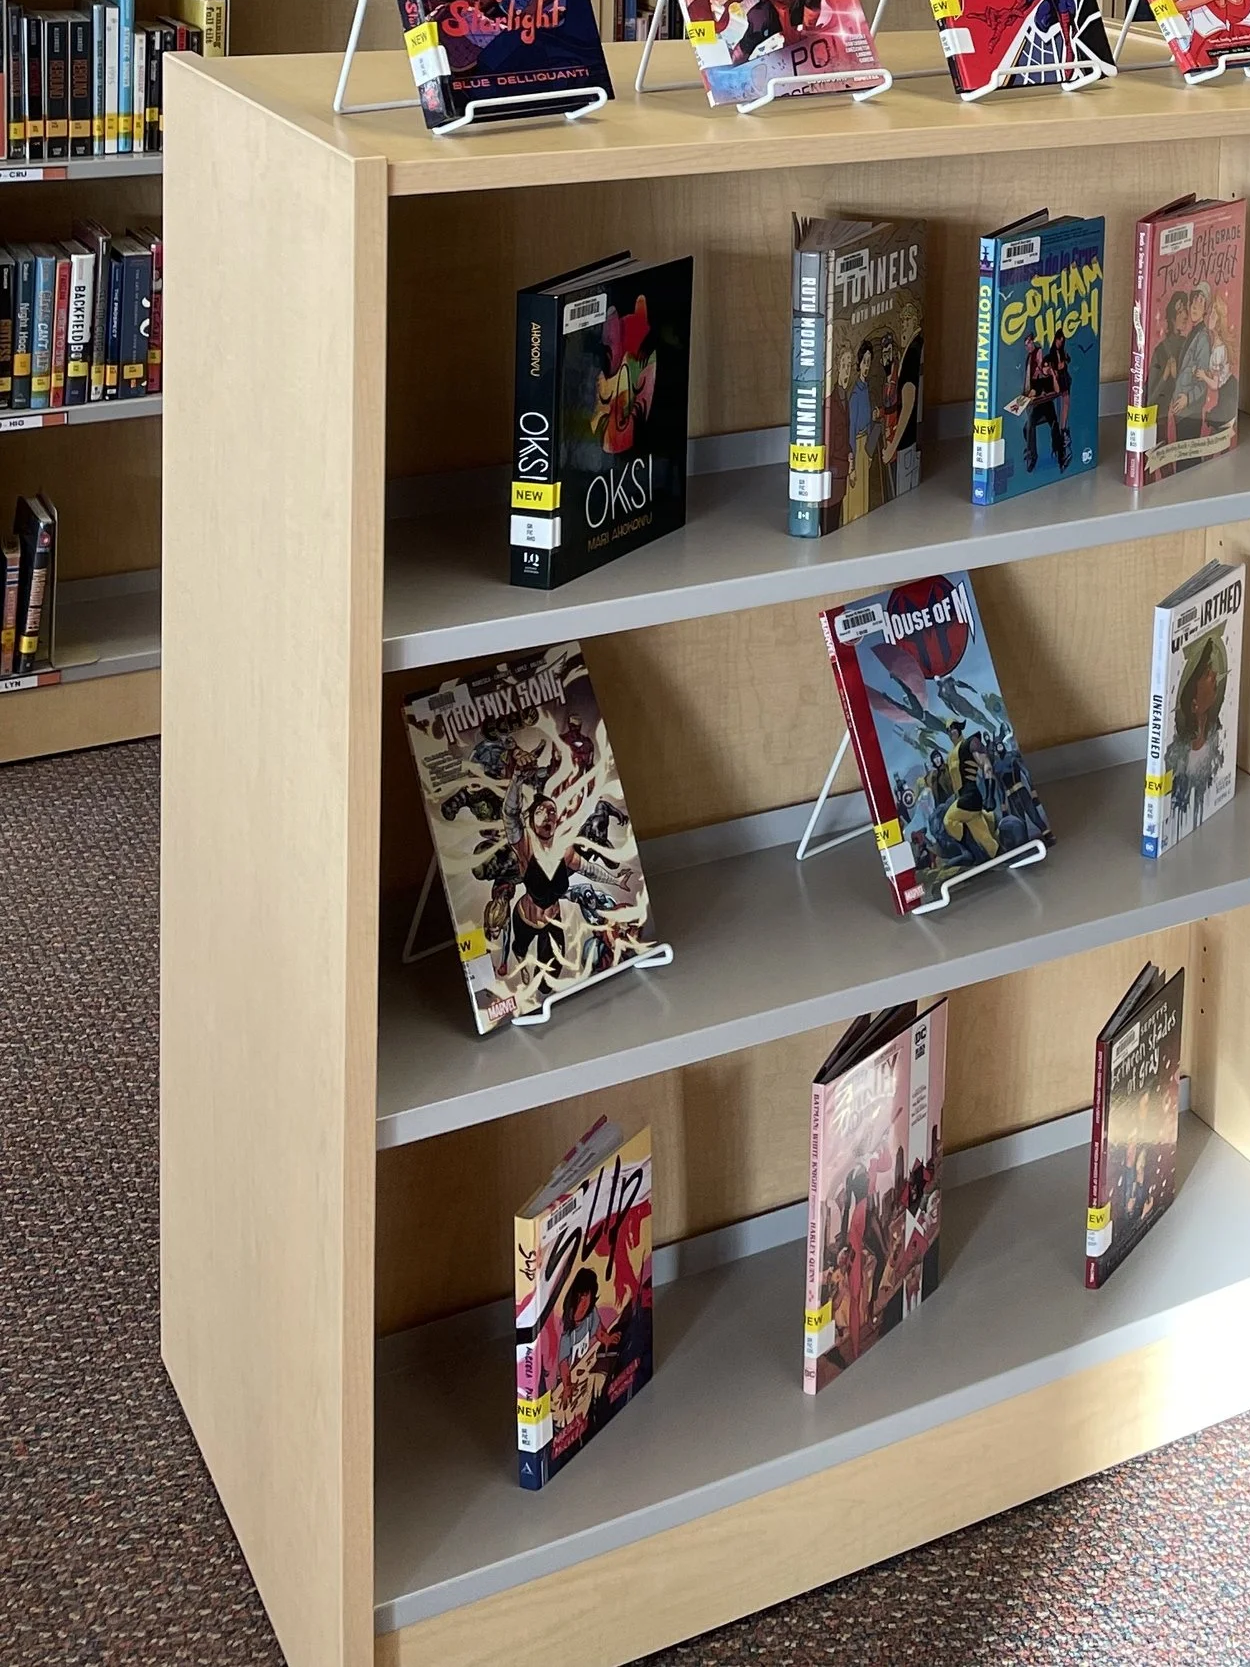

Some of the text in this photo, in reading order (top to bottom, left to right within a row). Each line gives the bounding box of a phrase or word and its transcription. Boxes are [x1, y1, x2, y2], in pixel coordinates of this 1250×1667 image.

[206, 28, 214, 44] tilt
[214, 6, 223, 49] running
[412, 32, 428, 46] NEW
[452, 68, 590, 90] BLUE DELLIQUANTI
[1215, 224, 1241, 244] GRADE
[842, 244, 918, 307] TUNNELS
[1158, 225, 1216, 296] Twelfth
[1196, 244, 1238, 286] Night
[18, 302, 29, 327] Night
[71, 286, 85, 342] BACKFIELD
[800, 276, 817, 367] RUTU MODAN
[1001, 256, 1104, 346] GOTHAM
[1034, 288, 1099, 347] HIGH
[38, 323, 48, 349] CAN'T
[530, 322, 541, 377] AHOKOIVU
[975, 284, 992, 413] GOTHAM HIGH
[973, 424, 996, 435] NEW
[1127, 412, 1149, 423] NEW
[518, 411, 550, 481] OKSI
[793, 452, 818, 463] NEW
[516, 490, 543, 501] NEW
[585, 454, 653, 528] OKSI
[883, 581, 975, 646] HOUSE OF M
[819, 615, 836, 663] MARVEL
[442, 683, 516, 742] PHOENIX
[517, 669, 567, 709] SONG
[1150, 694, 1163, 760] UNEARTHED
[488, 998, 517, 1020] MARVEL
[1148, 1009, 1176, 1050] shades
[813, 1093, 821, 1132] BATMAN:
[519, 1243, 537, 1282] SLIP
[808, 1257, 816, 1282] QUINN
[517, 1404, 542, 1417] NEW
